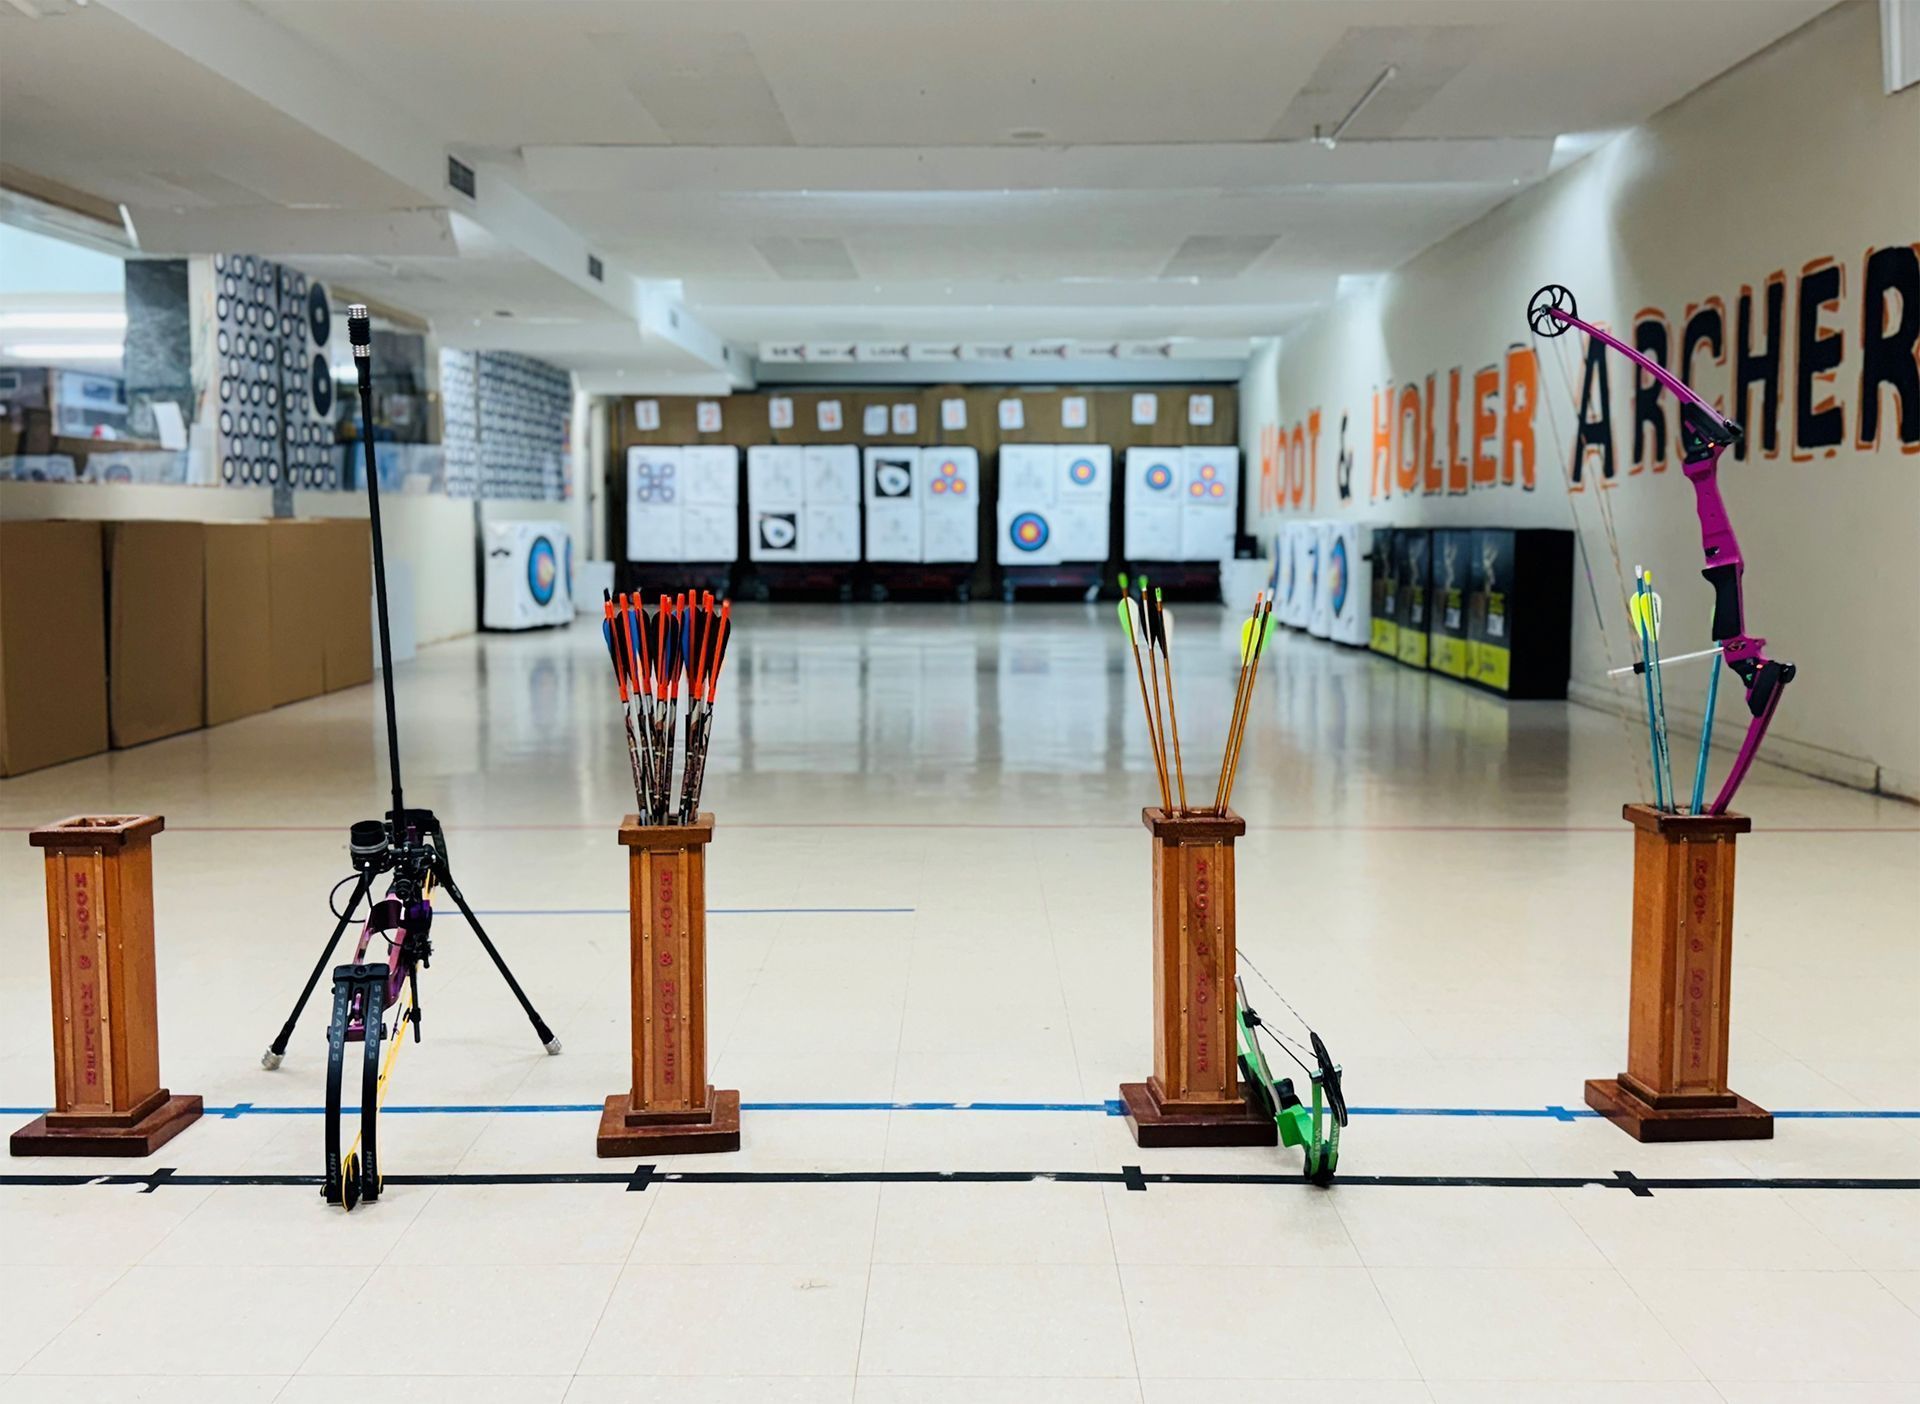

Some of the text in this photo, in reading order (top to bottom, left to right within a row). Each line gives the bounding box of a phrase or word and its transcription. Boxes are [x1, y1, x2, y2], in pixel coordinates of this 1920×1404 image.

[1259, 406, 1321, 514] HOOT
[1337, 409, 1353, 505] &
[1369, 342, 1539, 505] HOLLER
[331, 986, 347, 1062] STRATOS
[368, 984, 382, 1060] STRATOS
[328, 1152, 336, 1185] HOYT
